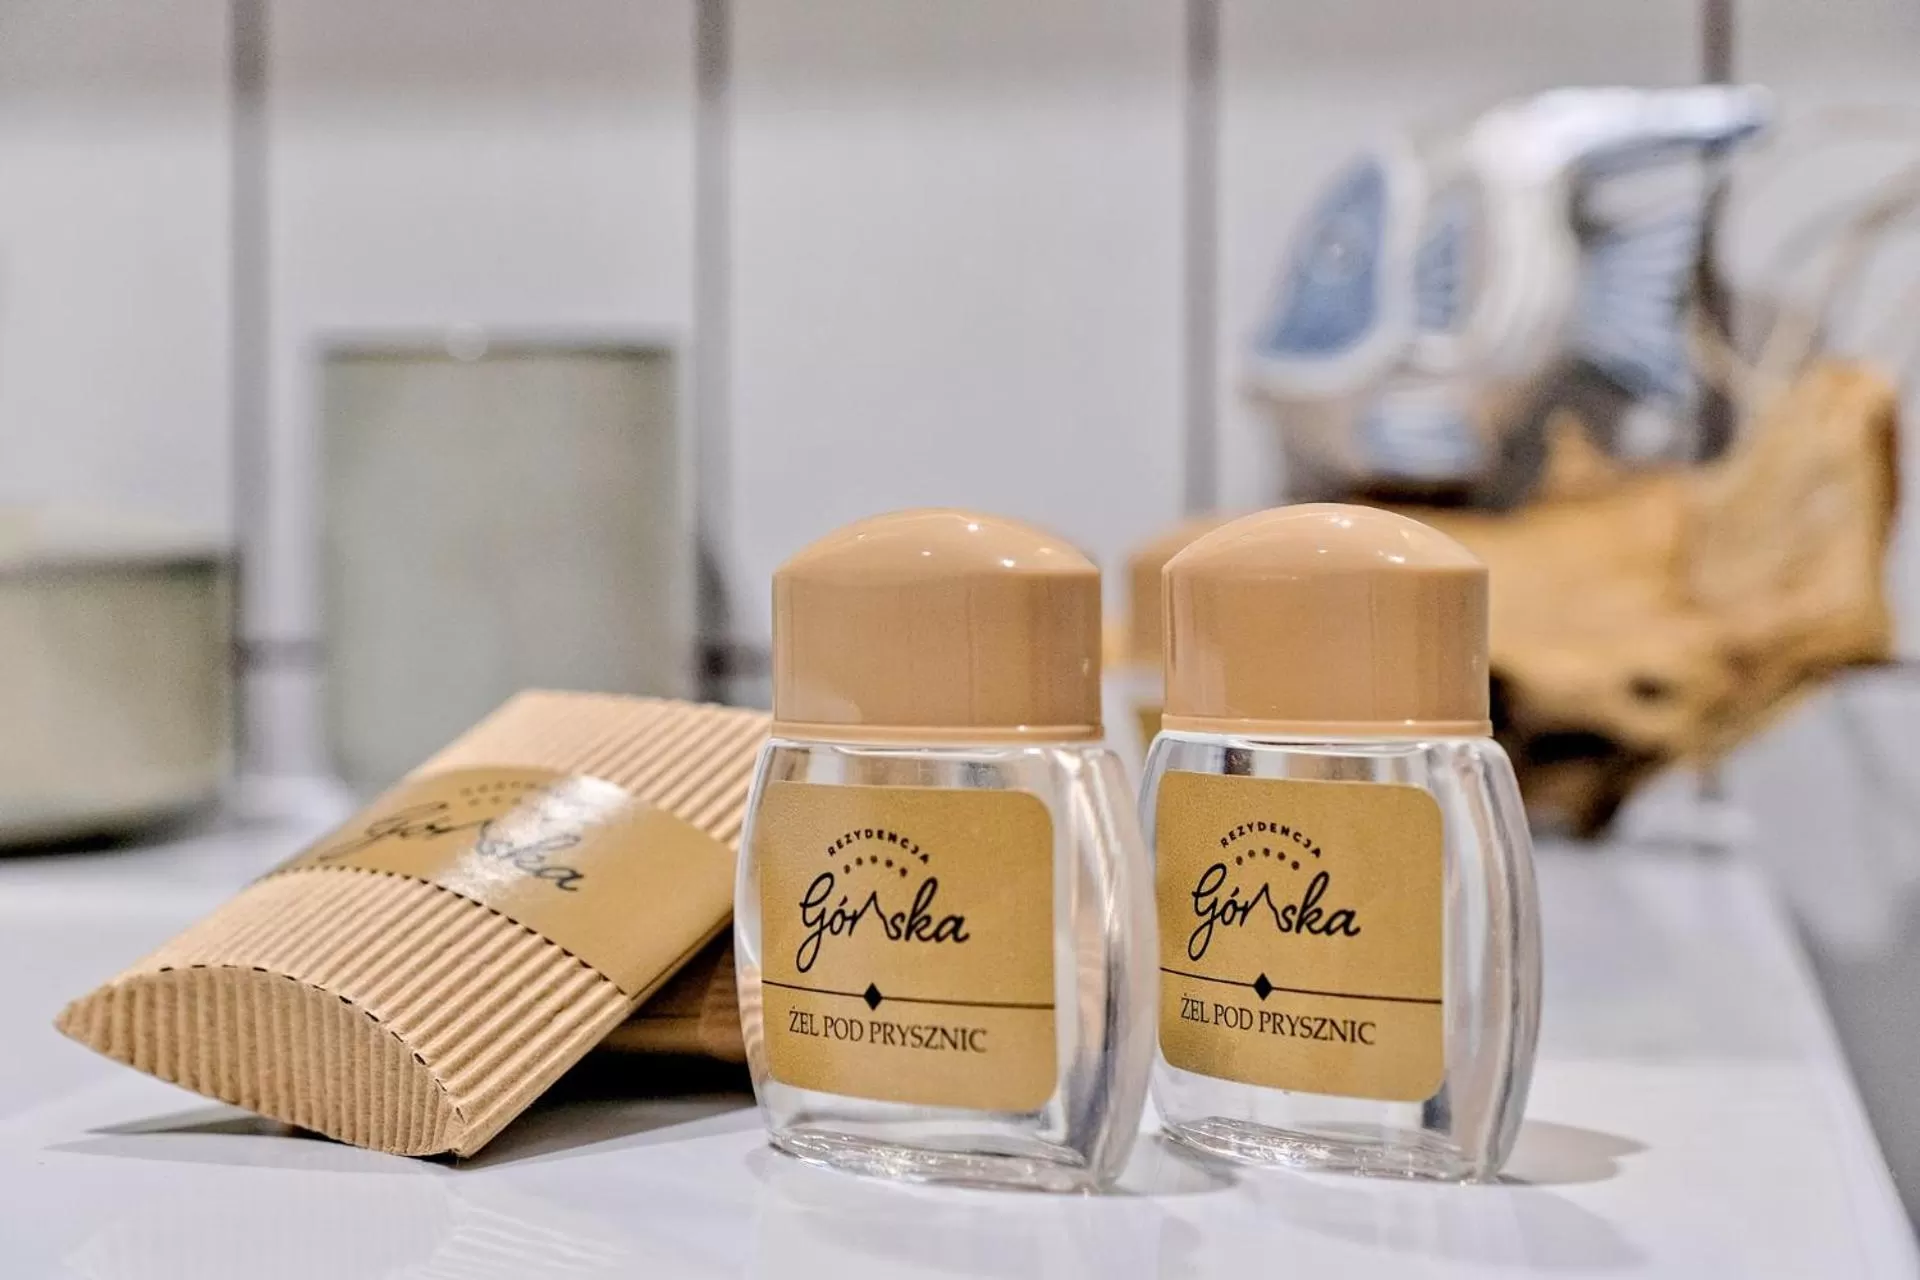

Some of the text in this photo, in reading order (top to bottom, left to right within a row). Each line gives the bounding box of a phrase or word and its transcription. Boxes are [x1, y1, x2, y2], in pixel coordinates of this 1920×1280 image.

[827, 829, 929, 864] REZYDENCJA
[1220, 821, 1322, 858] REZYDENCJA
[796, 872, 970, 973] Górska
[1188, 863, 1361, 961] Górska
[789, 1006, 988, 1053] ŻEL POD PRYSZNIC
[1181, 993, 1377, 1045] ŻEL POD PRYSZNIC
